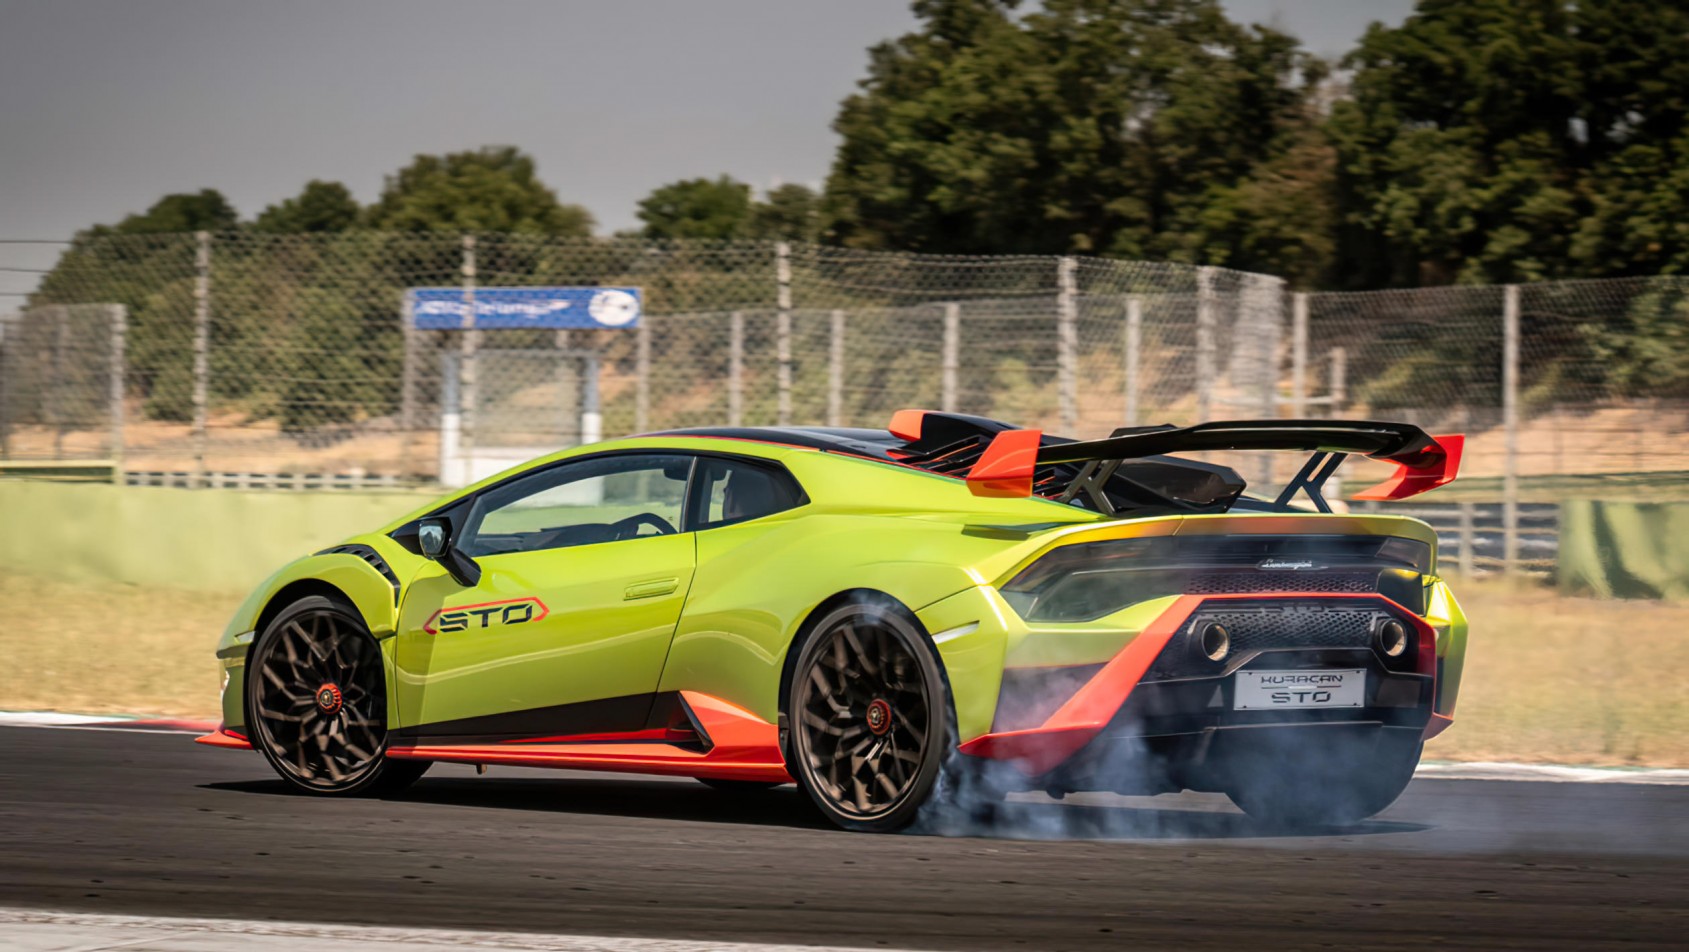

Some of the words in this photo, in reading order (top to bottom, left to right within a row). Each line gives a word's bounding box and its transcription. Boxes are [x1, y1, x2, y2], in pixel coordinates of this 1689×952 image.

[440, 603, 532, 633] STO
[1261, 675, 1343, 683] HURACAN
[1271, 691, 1331, 703] STO
